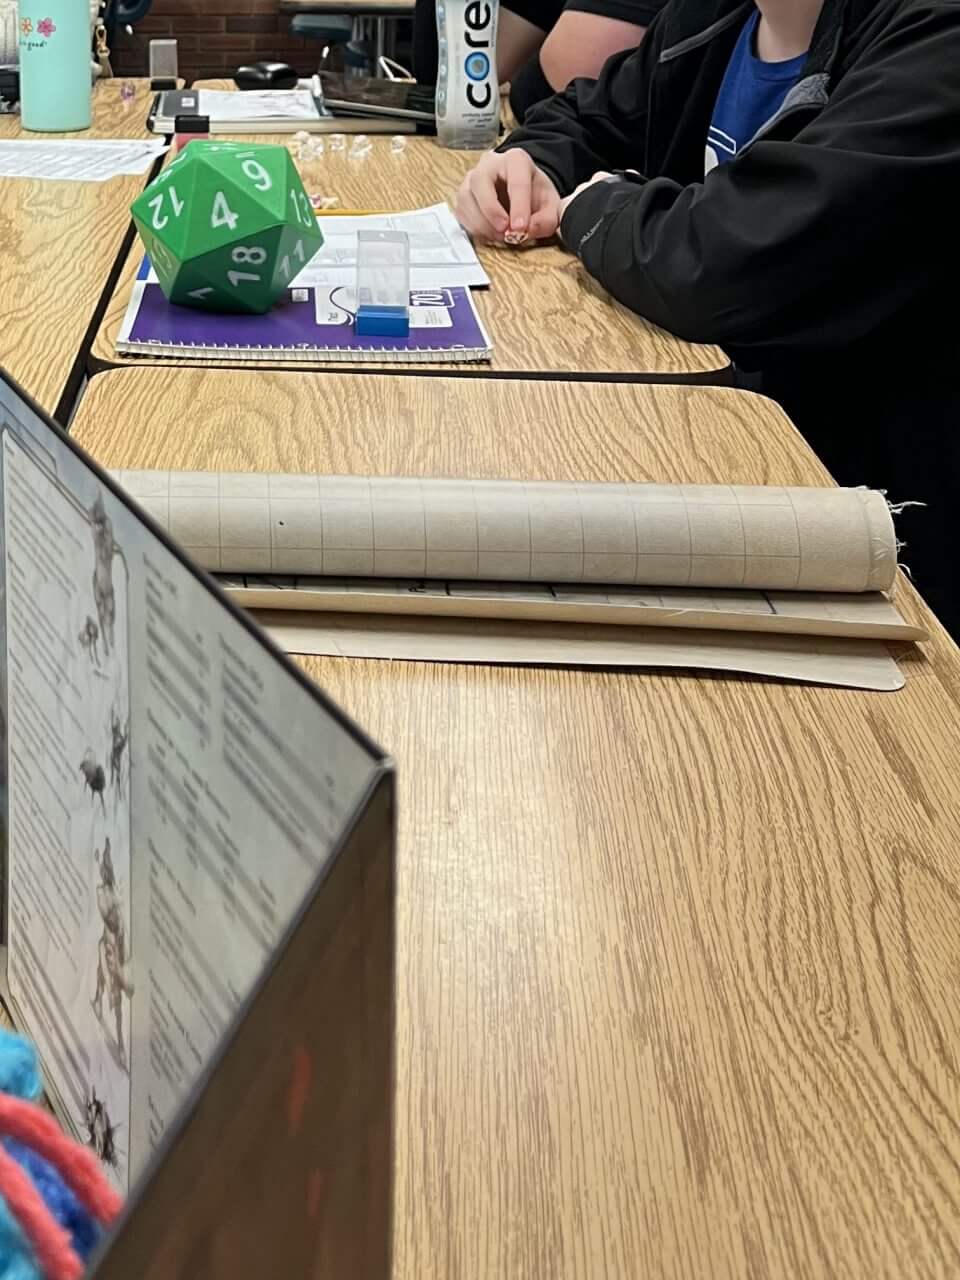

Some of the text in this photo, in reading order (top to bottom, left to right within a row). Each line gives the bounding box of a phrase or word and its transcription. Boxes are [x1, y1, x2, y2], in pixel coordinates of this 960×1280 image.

[464, 0, 492, 109] core
[211, 191, 239, 230] 4
[227, 246, 267, 287] 18
